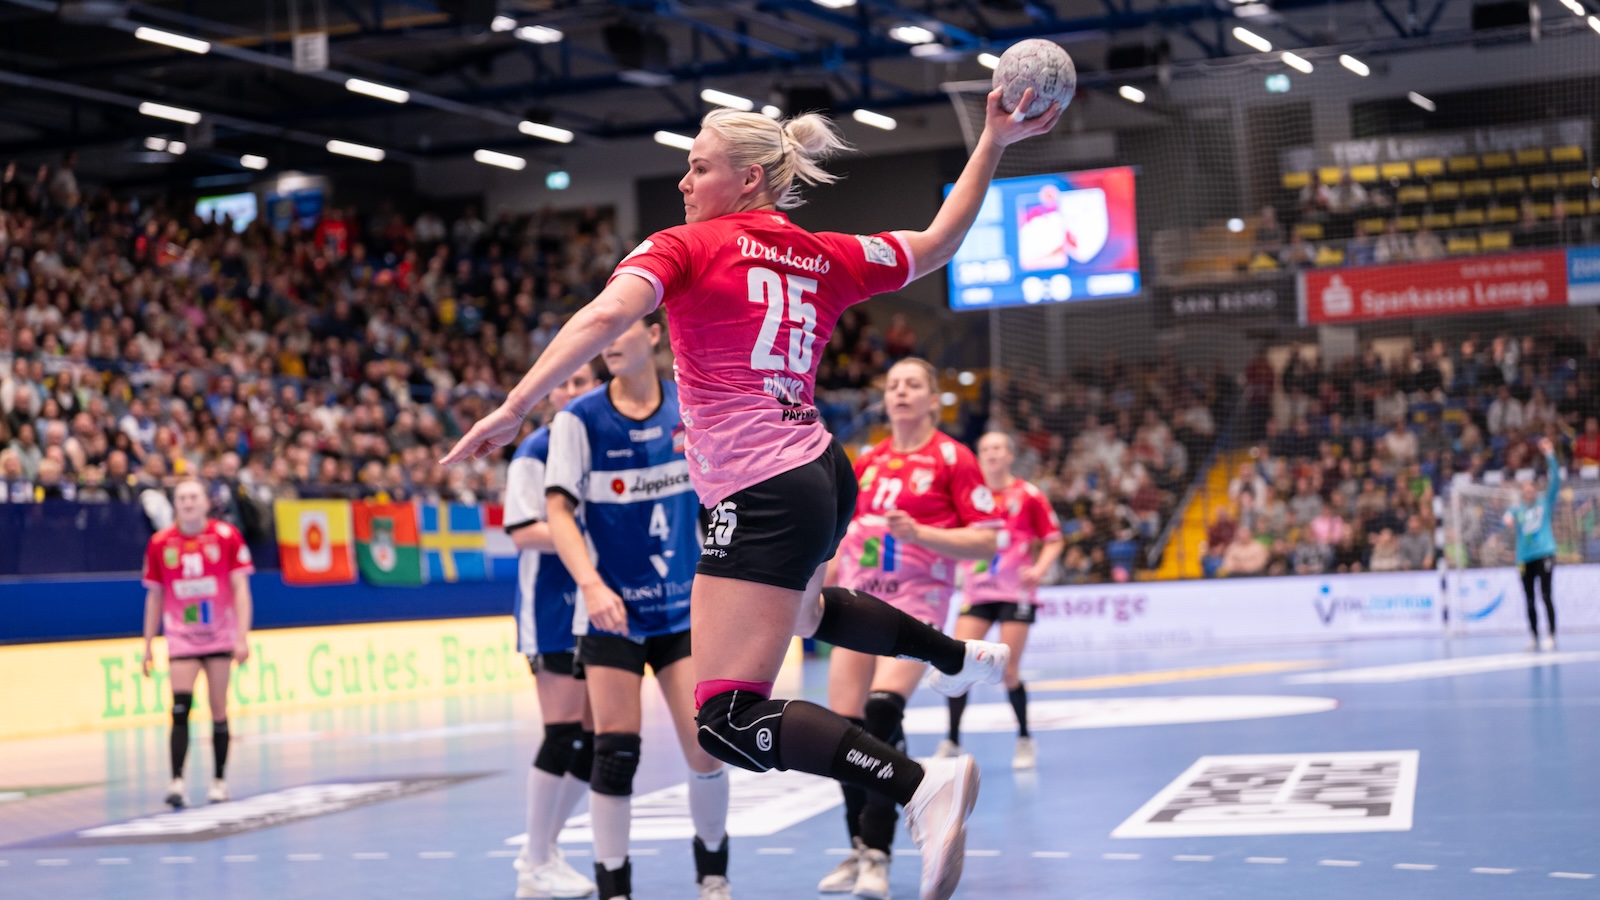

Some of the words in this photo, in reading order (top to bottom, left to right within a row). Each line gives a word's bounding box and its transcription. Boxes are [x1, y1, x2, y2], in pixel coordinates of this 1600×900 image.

[737, 236, 830, 274] Wildcats
[1361, 284, 1470, 316] Sparkasse
[1474, 279, 1549, 306] Lemgo
[747, 267, 818, 374] 25
[782, 409, 818, 422] PAPEN
[648, 502, 671, 541] 4
[701, 548, 720, 557] RAFT
[621, 583, 662, 601] itaSol
[100, 643, 295, 719] Einch.
[308, 640, 430, 698] Gutes.
[441, 635, 523, 686] Brot.
[845, 748, 882, 772] CRAFT
